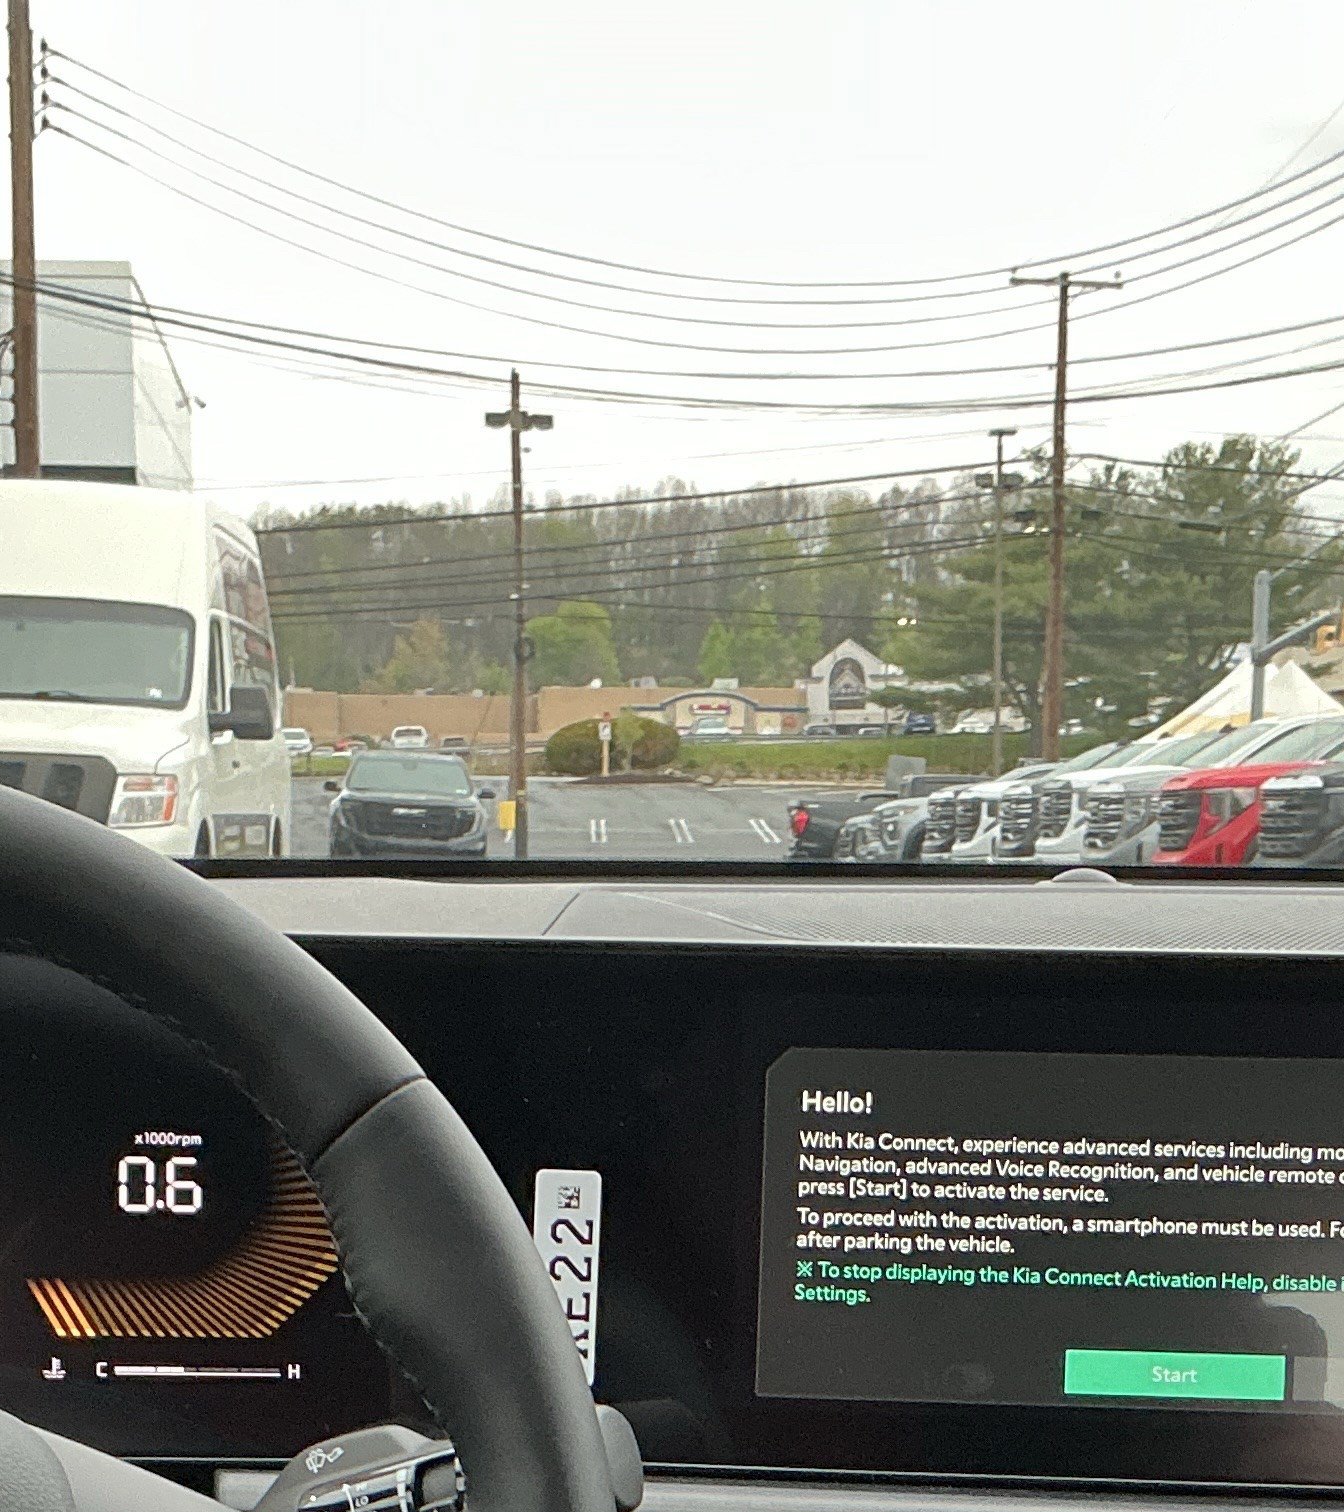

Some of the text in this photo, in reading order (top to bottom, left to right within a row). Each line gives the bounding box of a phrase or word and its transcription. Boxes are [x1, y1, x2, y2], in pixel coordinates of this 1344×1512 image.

[802, 1090, 873, 1114] Hello!
[134, 1132, 203, 1147] x1000rpm
[800, 1130, 842, 1149] With
[847, 1132, 874, 1150] Kia
[878, 1133, 958, 1153] Connect,
[962, 1138, 1059, 1157] experience
[1063, 1139, 1150, 1156] advanced
[1154, 1141, 1225, 1159] services
[1229, 1142, 1312, 1163] including
[799, 1154, 901, 1175] Navigation,
[905, 1159, 991, 1176] advanced
[996, 1160, 1044, 1178] Voice
[1048, 1161, 1159, 1183] Recognition,
[1164, 1164, 1197, 1181] and
[1202, 1165, 1265, 1183] vehicle
[1269, 1169, 1335, 1184] remote
[118, 1155, 203, 1214] 0.6
[798, 1178, 1109, 1203] press [Start] to activate the service.
[797, 1207, 819, 1225] To
[823, 1210, 895, 1231] proceed
[898, 1211, 936, 1228] with
[941, 1212, 970, 1229] the
[974, 1213, 1068, 1234] activation,
[1073, 1220, 1083, 1232] a
[1087, 1216, 1197, 1237] smartphone
[1202, 1220, 1248, 1237] must
[1251, 1219, 1274, 1238] be
[1278, 1222, 1325, 1238] used.
[796, 1232, 1015, 1254] after parking the vehicle.
[817, 1261, 840, 1279] To
[843, 1264, 882, 1283] stop
[886, 1263, 975, 1286] displaying
[979, 1267, 1008, 1283] the
[1013, 1268, 1041, 1285] Kia
[1045, 1269, 1122, 1286] Connect
[1125, 1271, 1217, 1289] Activation
[1222, 1273, 1269, 1293] Help,
[1273, 1275, 1337, 1292] disable
[794, 1284, 872, 1306] Settings.
[95, 1362, 108, 1378] C
[287, 1363, 301, 1379] H
[1151, 1365, 1199, 1386] Start
